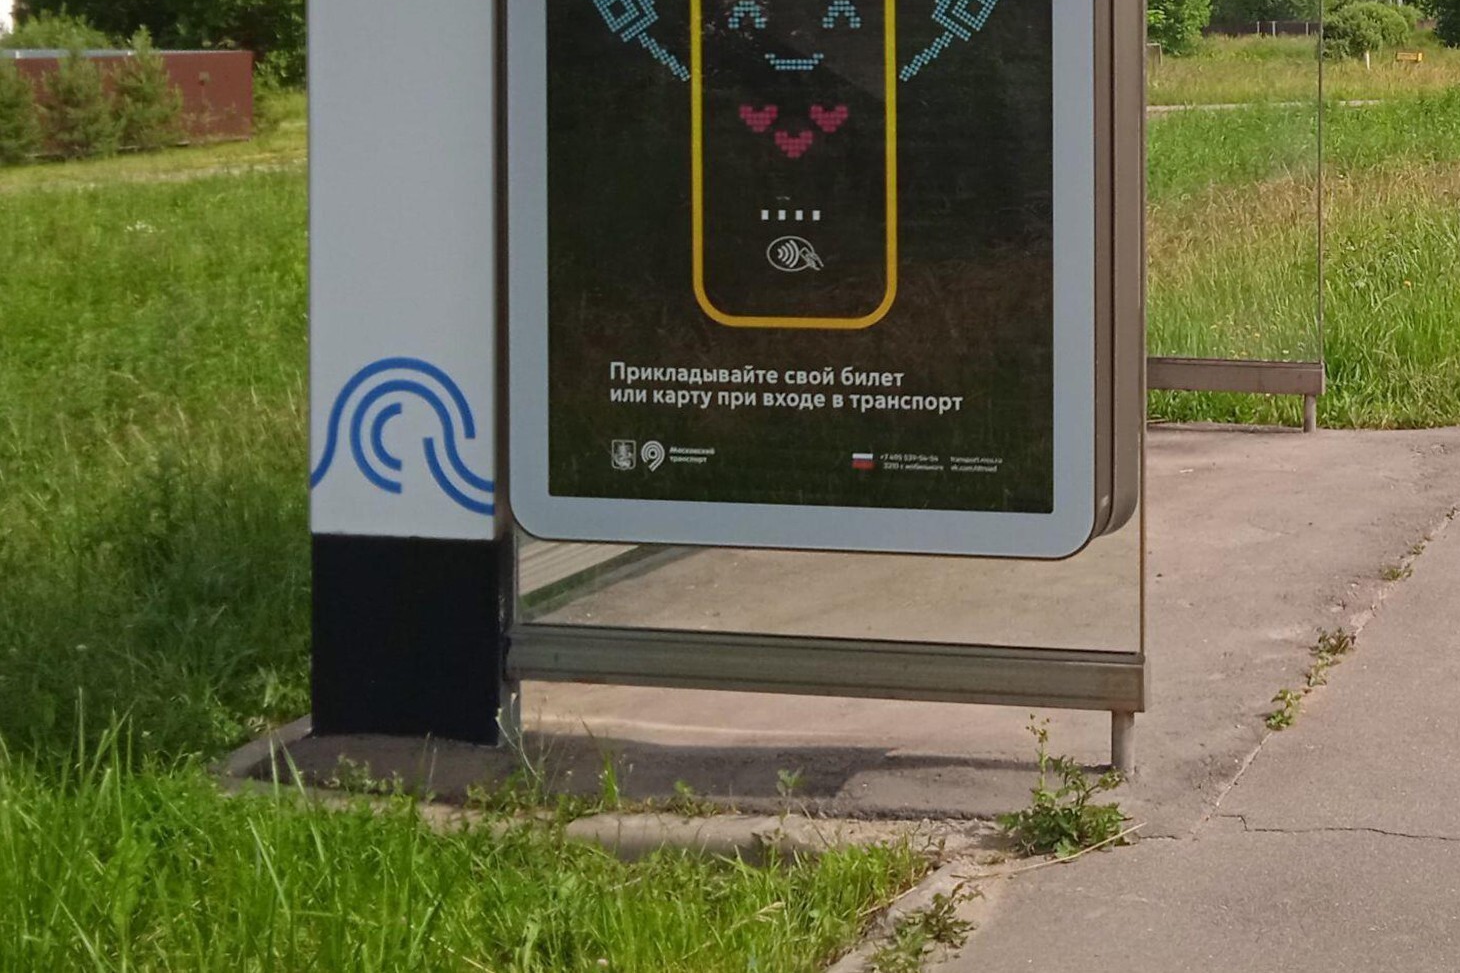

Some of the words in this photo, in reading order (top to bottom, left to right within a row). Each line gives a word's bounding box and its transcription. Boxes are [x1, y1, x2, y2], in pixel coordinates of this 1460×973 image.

[609, 361, 778, 385] Прикладывайте
[784, 367, 835, 386] свой
[840, 366, 905, 387] билет
[609, 388, 647, 403] или
[652, 389, 713, 409] карту
[717, 391, 757, 410] при
[763, 392, 826, 410] входе
[832, 394, 844, 408] в
[849, 394, 963, 415] транспорт
